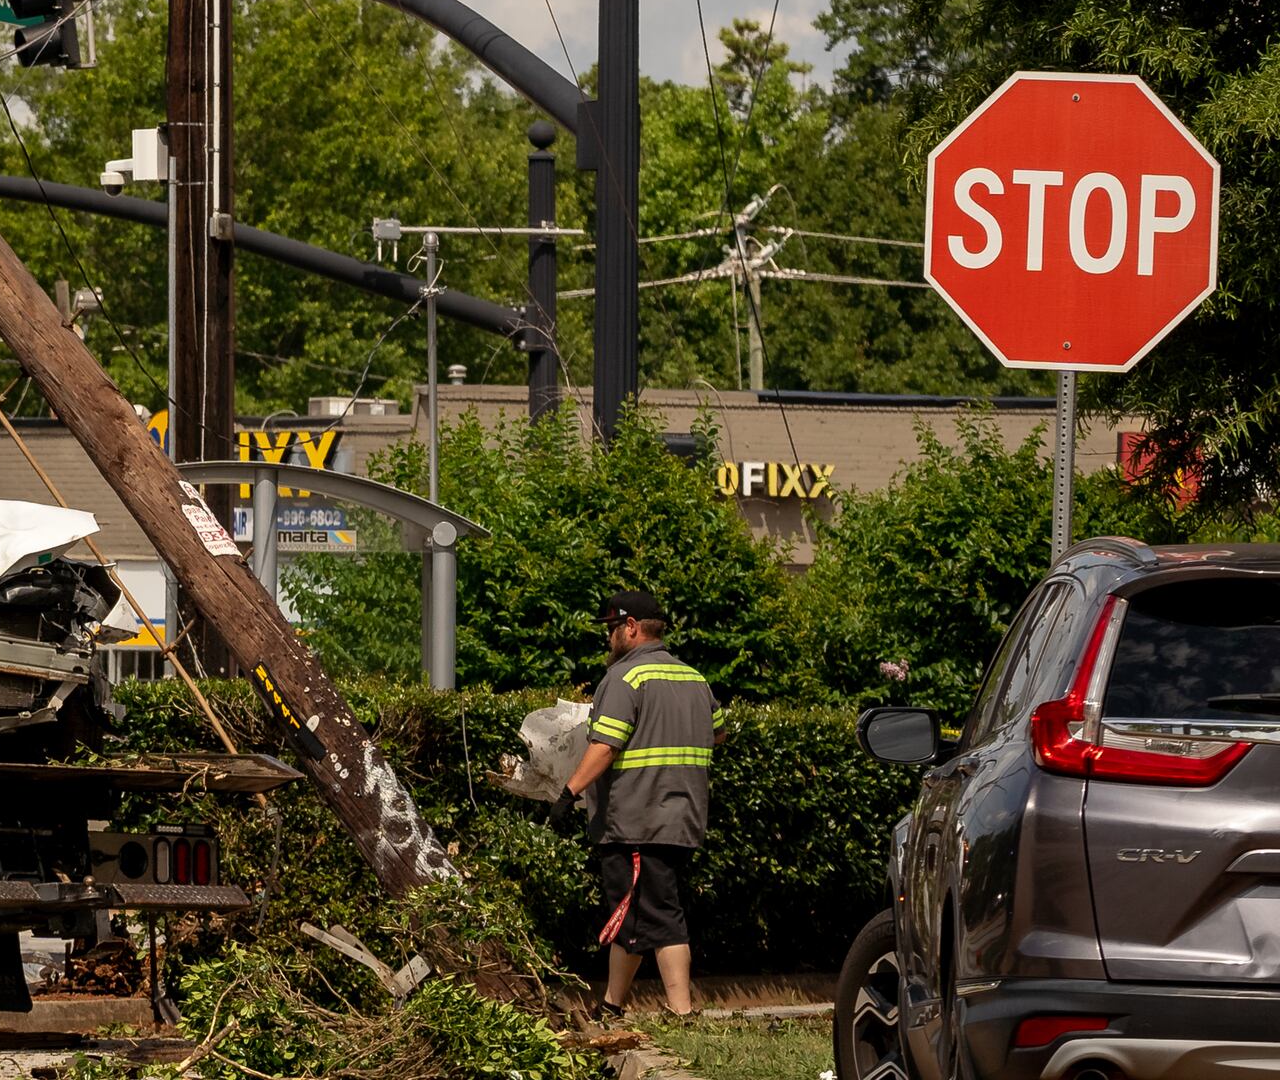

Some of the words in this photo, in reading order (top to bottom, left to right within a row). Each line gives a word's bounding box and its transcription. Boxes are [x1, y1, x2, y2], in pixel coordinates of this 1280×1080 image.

[947, 167, 1196, 276] STOP
[277, 531, 328, 543] marta
[1116, 848, 1202, 863] CR-V
